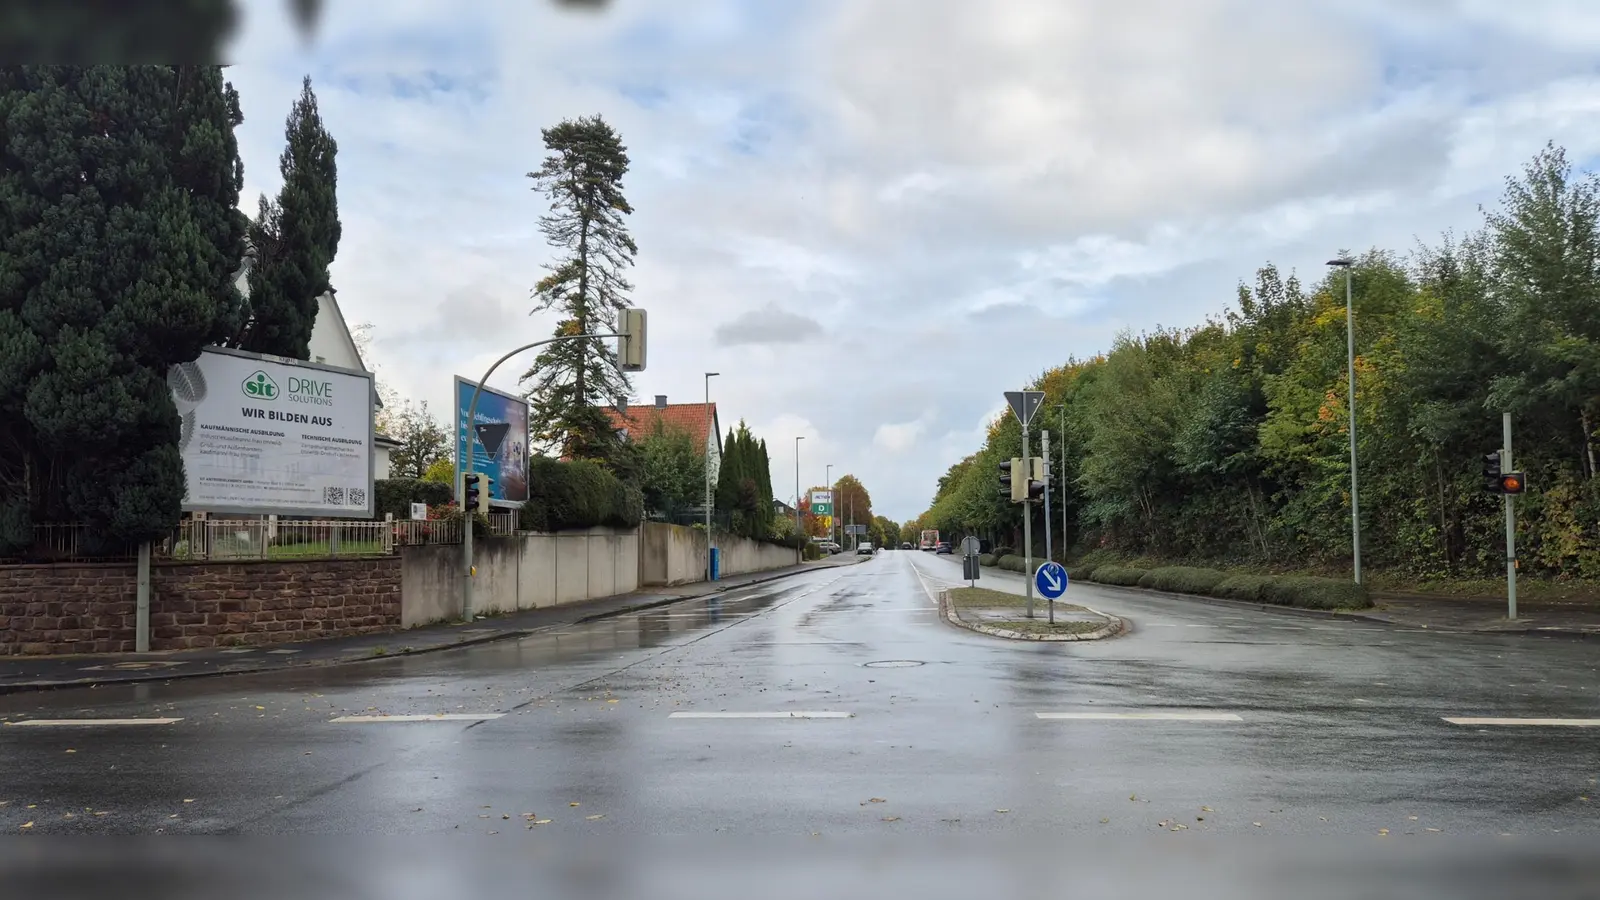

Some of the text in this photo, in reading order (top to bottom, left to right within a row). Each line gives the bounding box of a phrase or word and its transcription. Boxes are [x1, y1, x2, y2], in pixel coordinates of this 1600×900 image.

[246, 374, 275, 396] sit
[288, 377, 332, 398] DRIVE
[288, 394, 332, 406] SOLUTIONS
[242, 407, 332, 426] WIR BILDEN AUS
[200, 424, 285, 437] KAUFMÄNNISCHE AUSBILDUNG
[301, 434, 331, 442] TECHNISCHE
